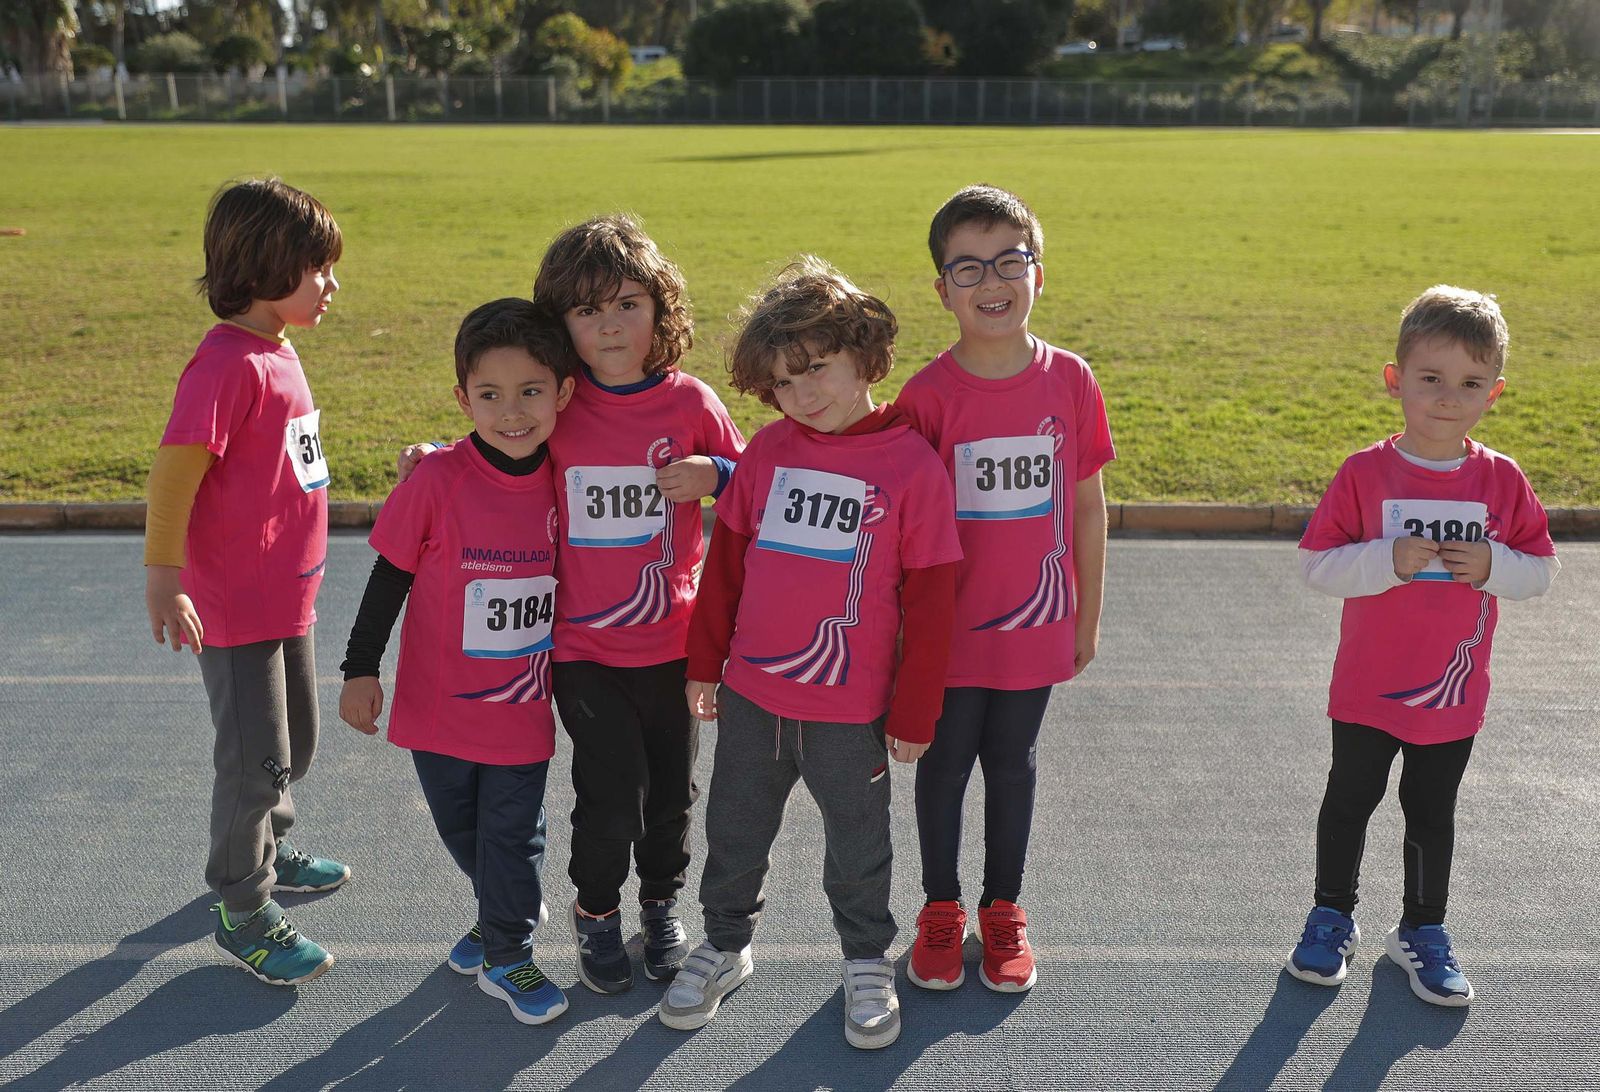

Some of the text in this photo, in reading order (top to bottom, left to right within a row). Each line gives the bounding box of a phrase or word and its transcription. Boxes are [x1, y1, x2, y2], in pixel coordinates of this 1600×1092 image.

[976, 454, 1051, 492] 3183
[586, 484, 663, 519] 3182
[784, 488, 860, 534] 3179
[1403, 518, 1483, 543] 3180
[460, 560, 512, 573] atletismo
[461, 547, 550, 563] INMACULADA
[487, 592, 552, 631] 3184
